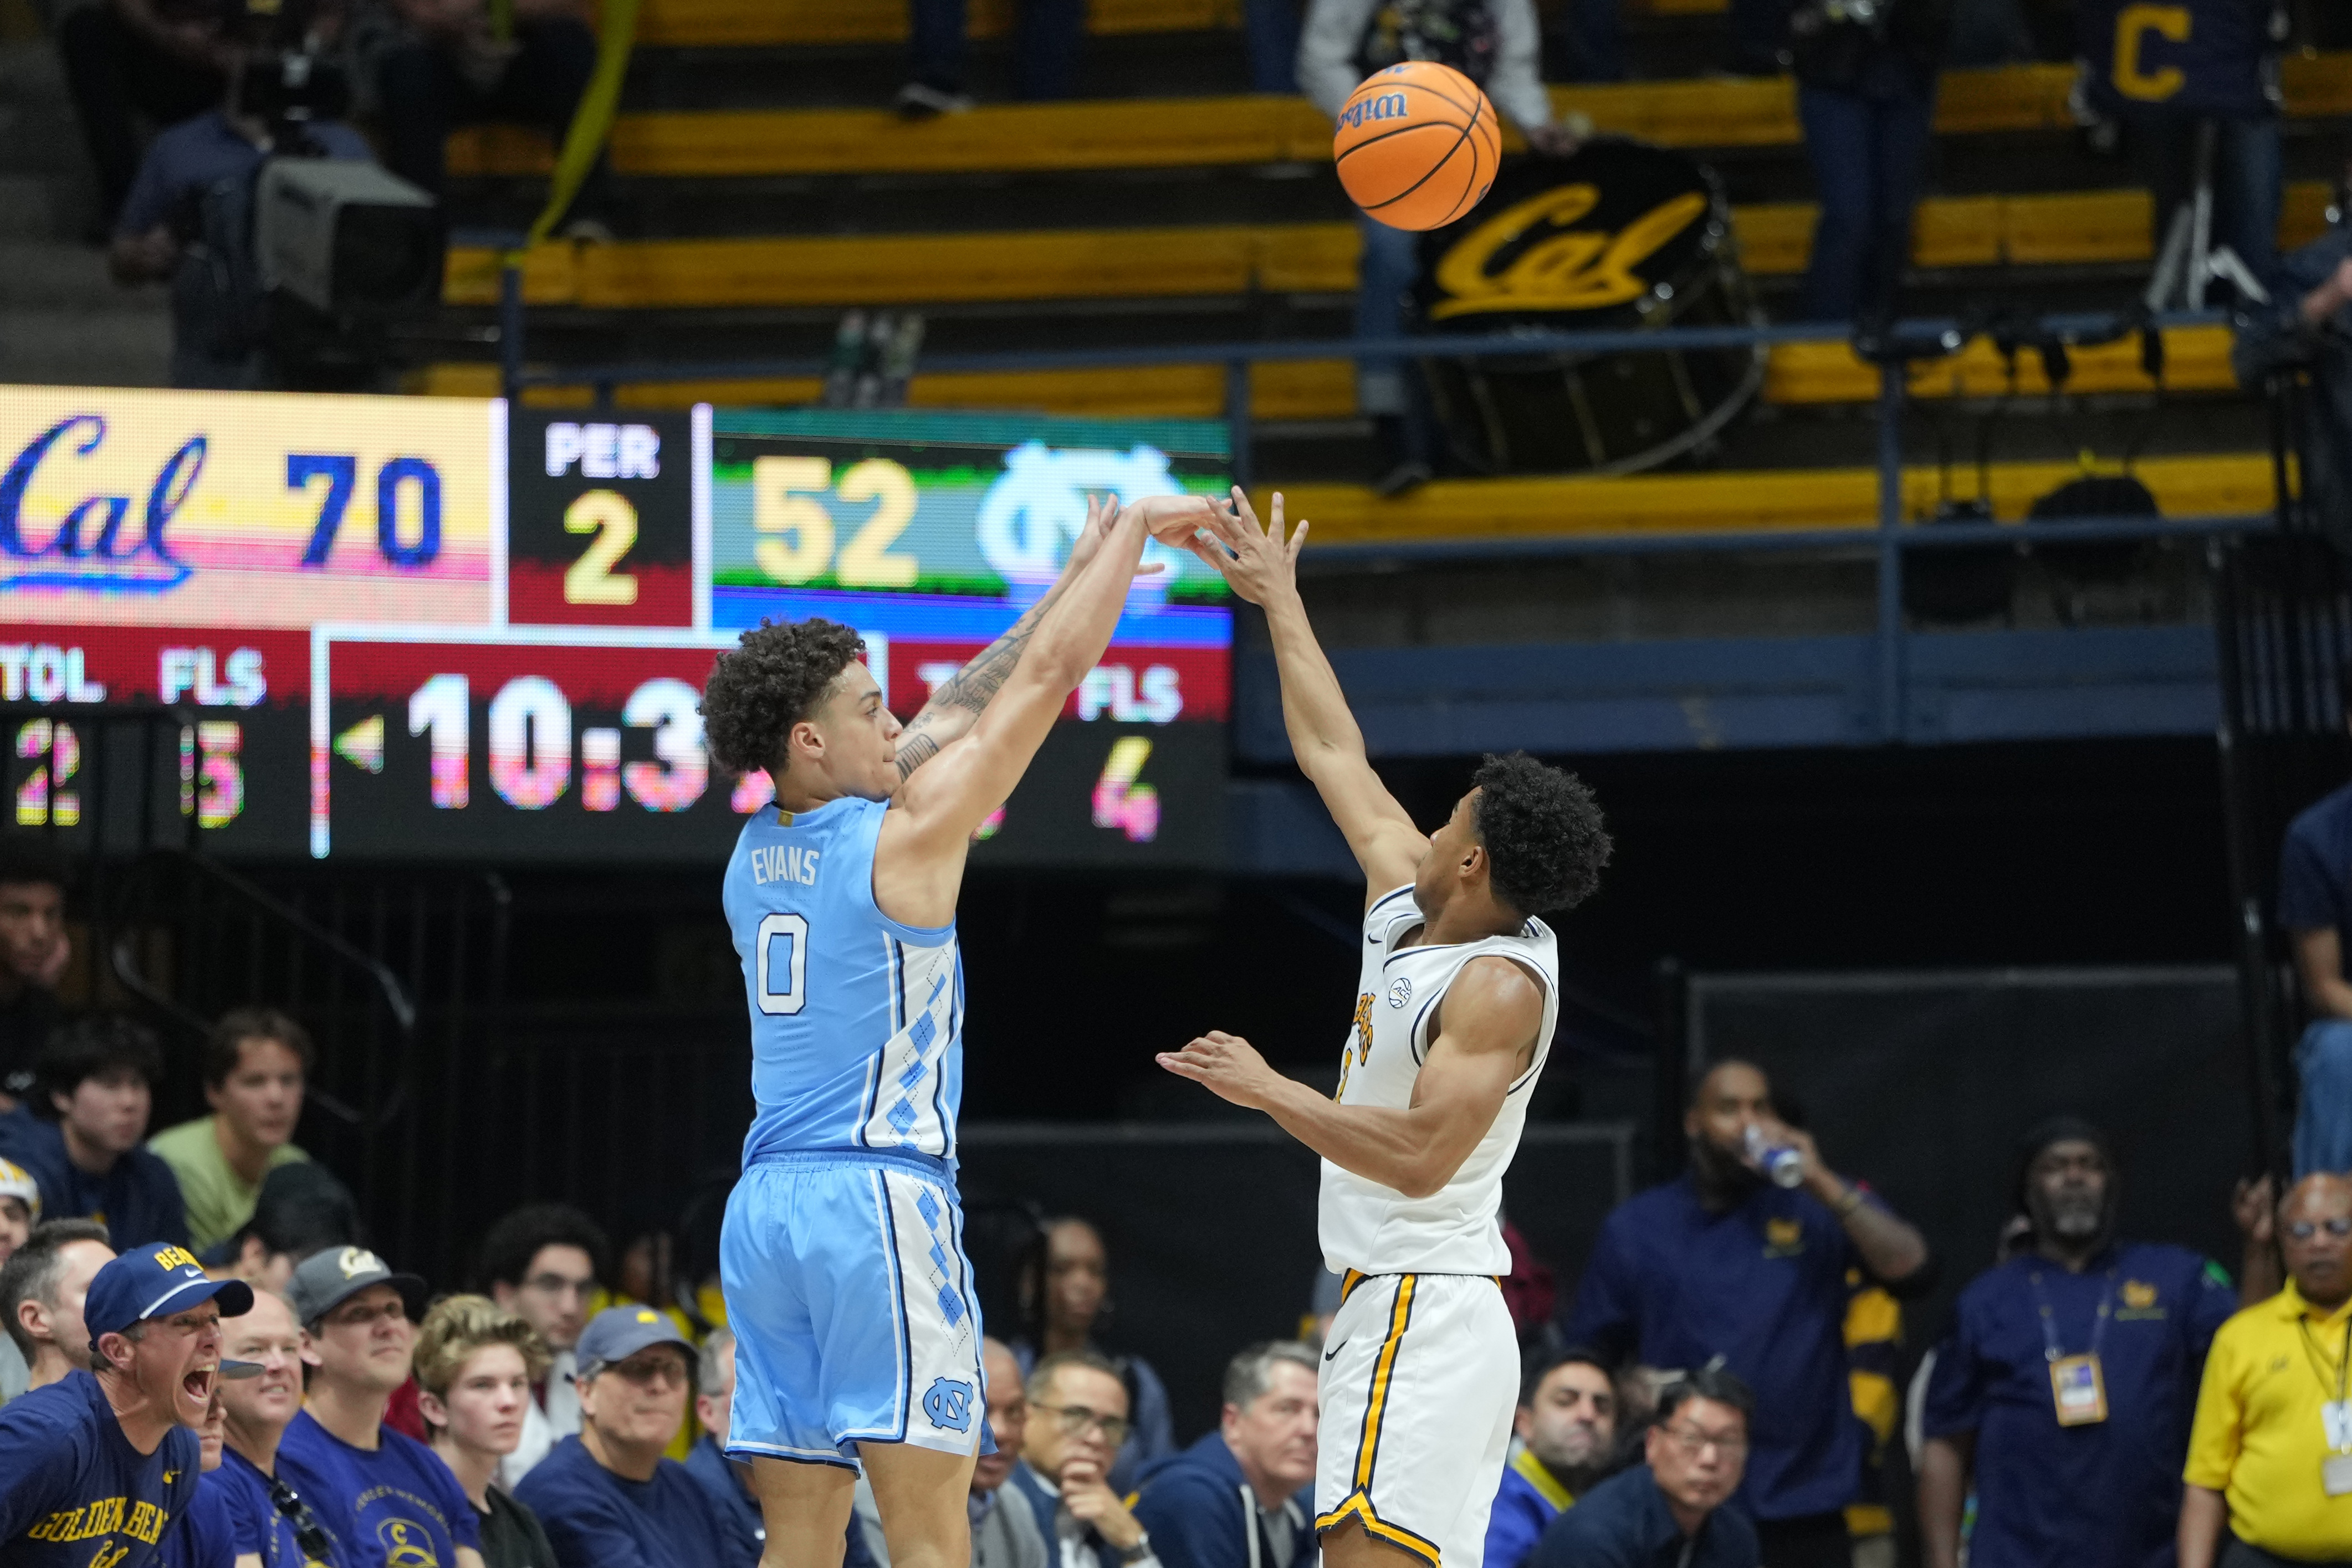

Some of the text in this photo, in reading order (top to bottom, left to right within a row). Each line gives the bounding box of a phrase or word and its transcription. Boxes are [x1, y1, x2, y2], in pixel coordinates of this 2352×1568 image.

[2113, 4, 2192, 101] C
[1430, 182, 1707, 320] Cal
[0, 414, 208, 576] Cal
[545, 423, 659, 479] PER
[287, 453, 443, 567] 70
[564, 489, 638, 604] 2
[752, 455, 919, 587] 52
[0, 643, 106, 703] TOL
[161, 645, 267, 706] FLS
[1078, 664, 1184, 724] FLS
[408, 673, 776, 814] 10:3
[751, 846, 820, 886] EVANS
[756, 912, 809, 1016] 0
[1393, 986, 1410, 1000] ACC
[28, 1497, 127, 1542] GOLDEN
